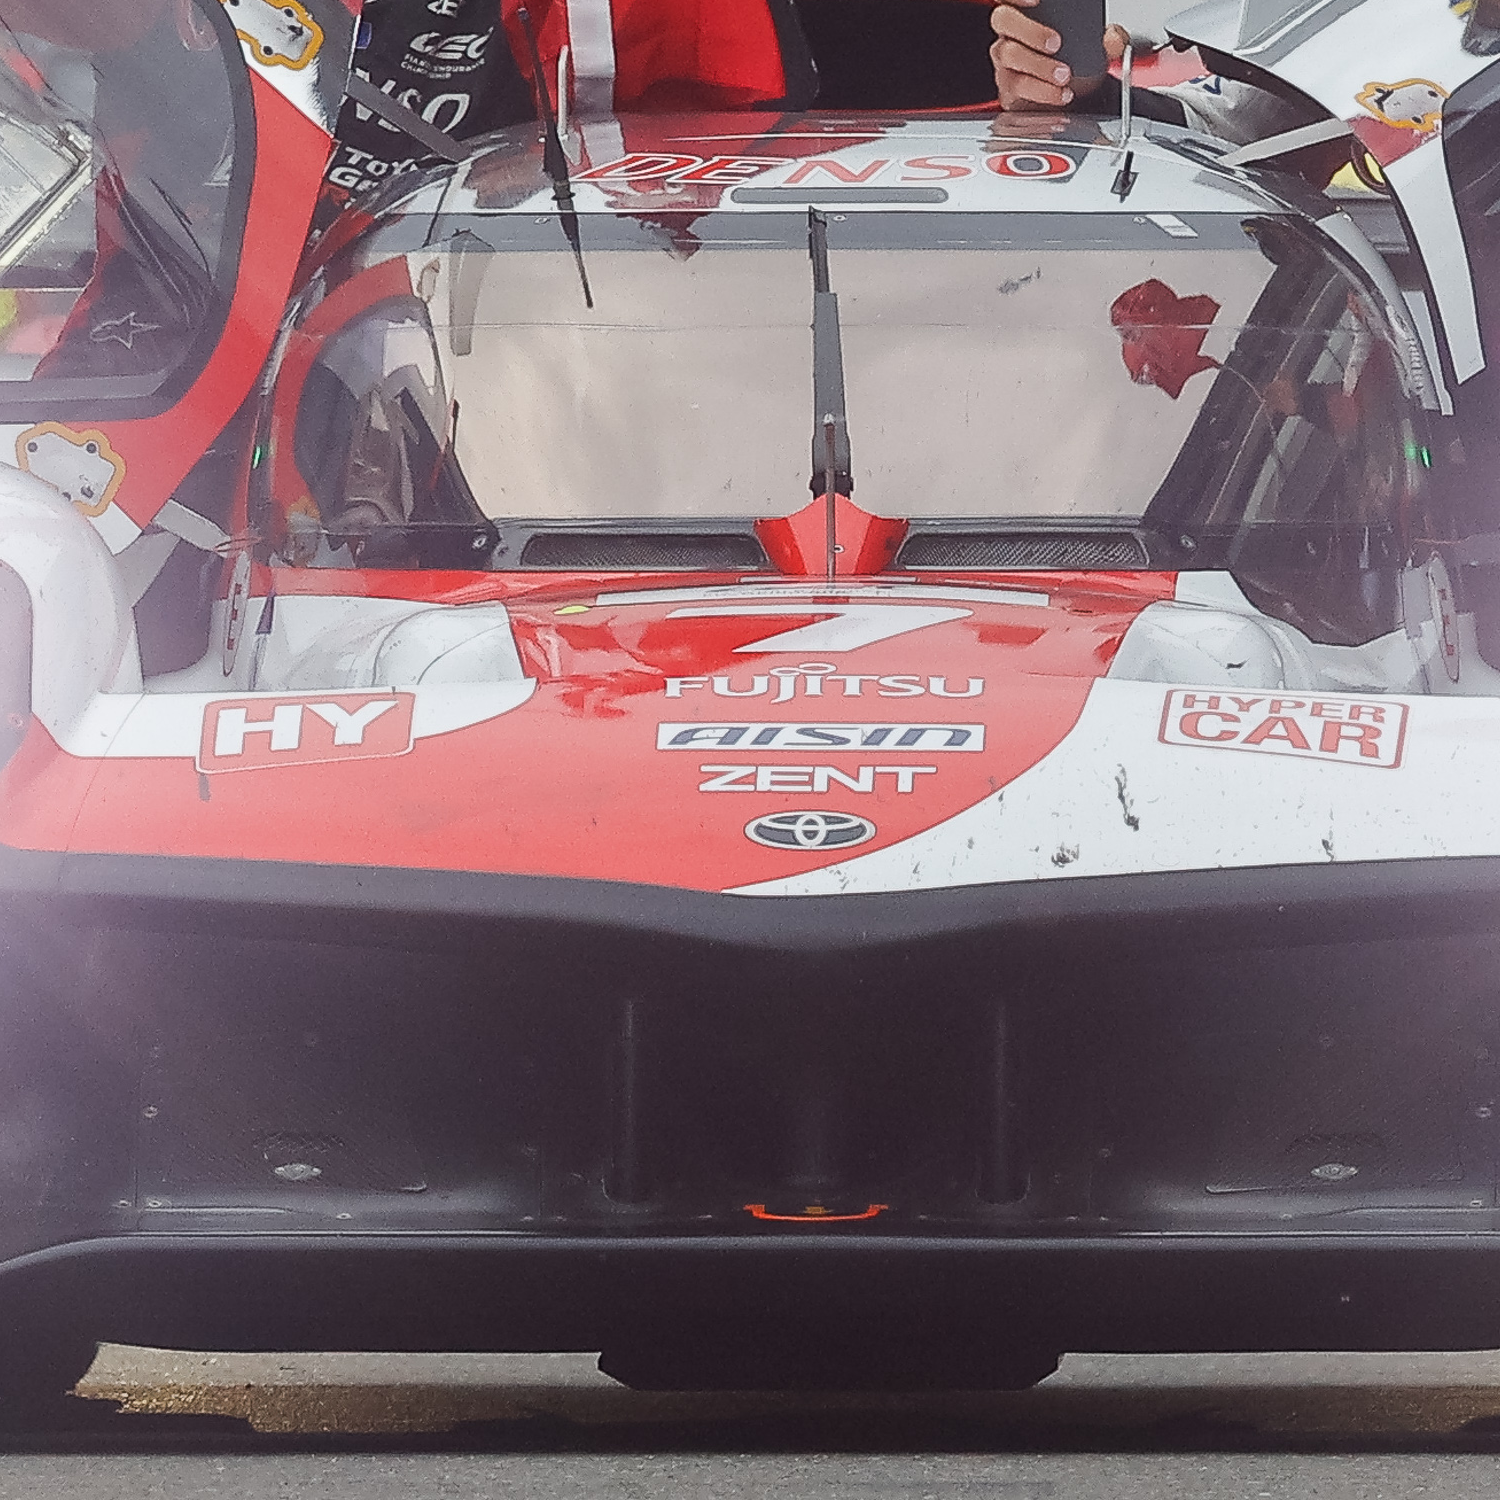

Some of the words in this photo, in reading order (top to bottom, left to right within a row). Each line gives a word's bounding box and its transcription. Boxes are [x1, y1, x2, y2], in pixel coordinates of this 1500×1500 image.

[570, 150, 1078, 186] DENSO
[665, 603, 974, 653] 7
[662, 663, 985, 703] FUJITSU
[1182, 693, 1387, 723] HYPER
[213, 699, 400, 757] HY
[666, 725, 973, 748] AISIN
[1179, 711, 1383, 760] CAR
[698, 764, 938, 794] ZENT
